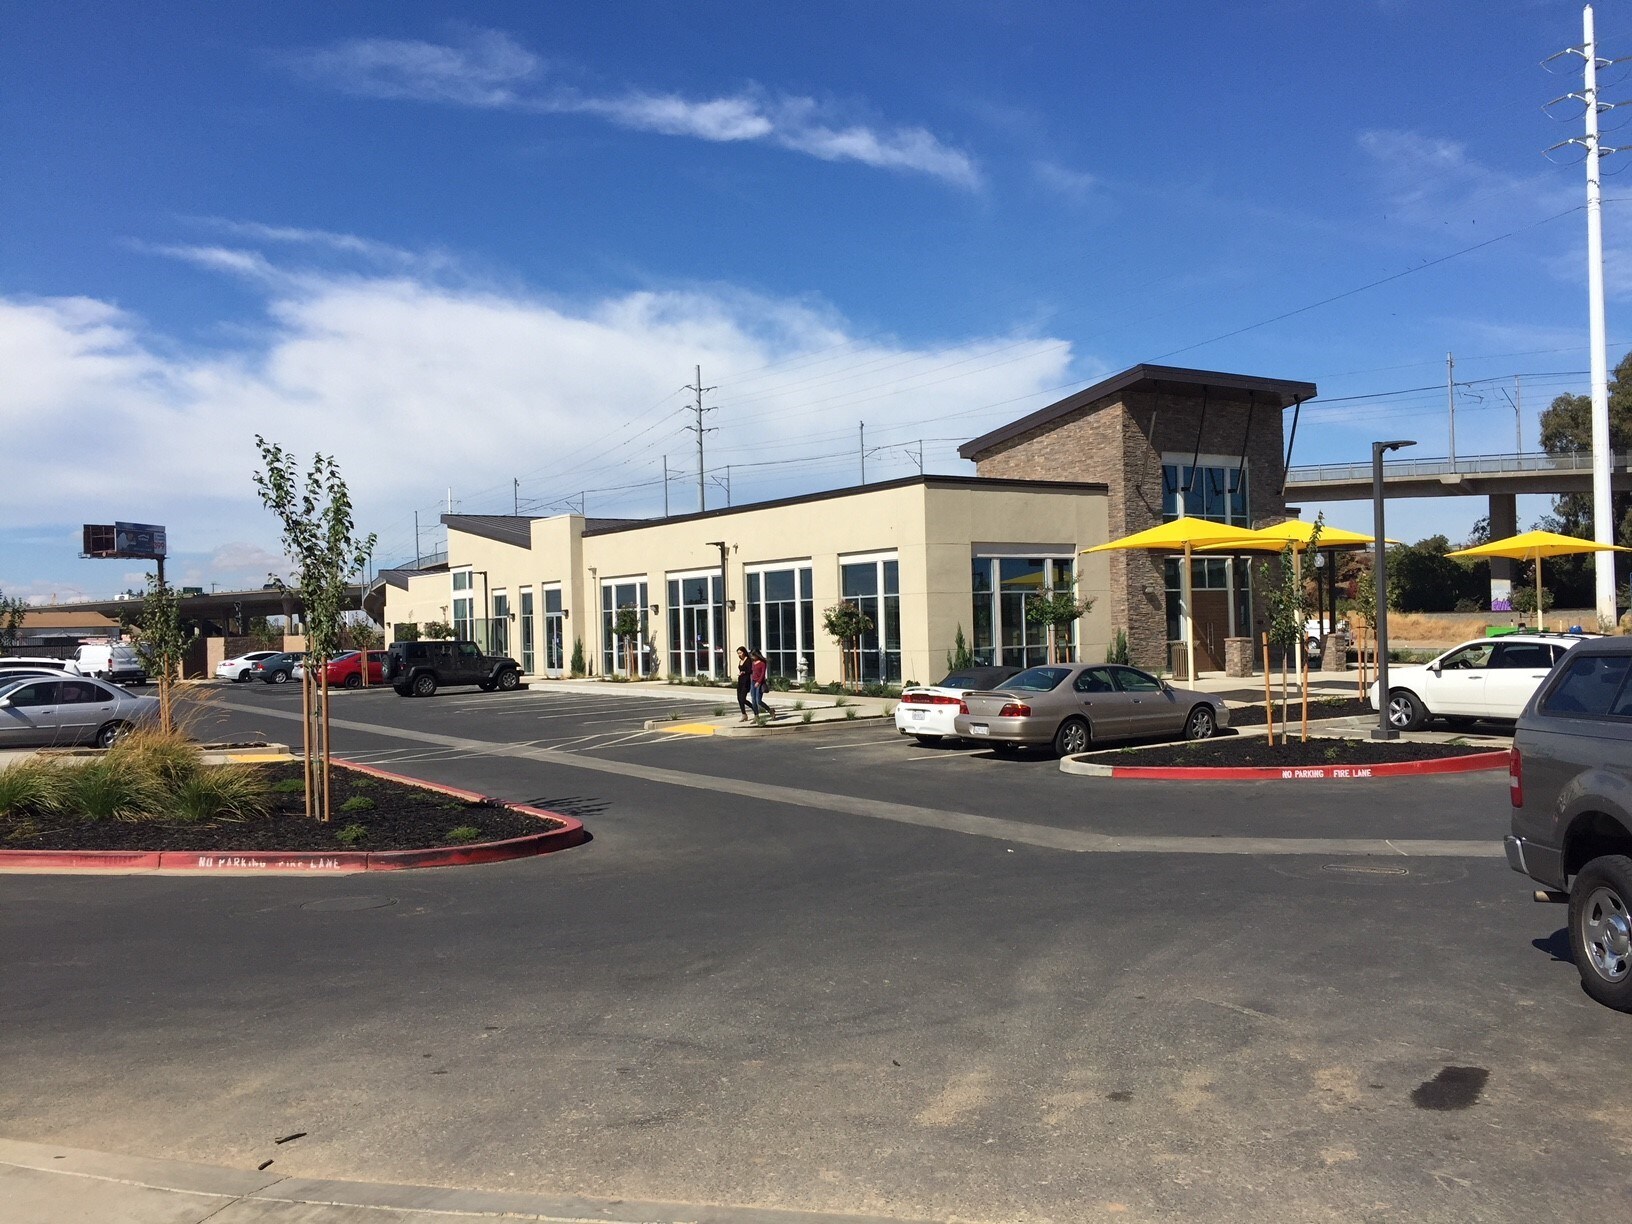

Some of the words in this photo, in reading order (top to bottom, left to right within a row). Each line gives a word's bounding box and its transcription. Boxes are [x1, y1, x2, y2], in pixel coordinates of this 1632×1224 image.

[1282, 770, 1292, 779] NO
[1294, 769, 1324, 778] PARKING
[1333, 768, 1350, 778] FIRE
[1352, 768, 1372, 777] LANE
[198, 856, 213, 867] NO
[310, 857, 341, 869] LANE
